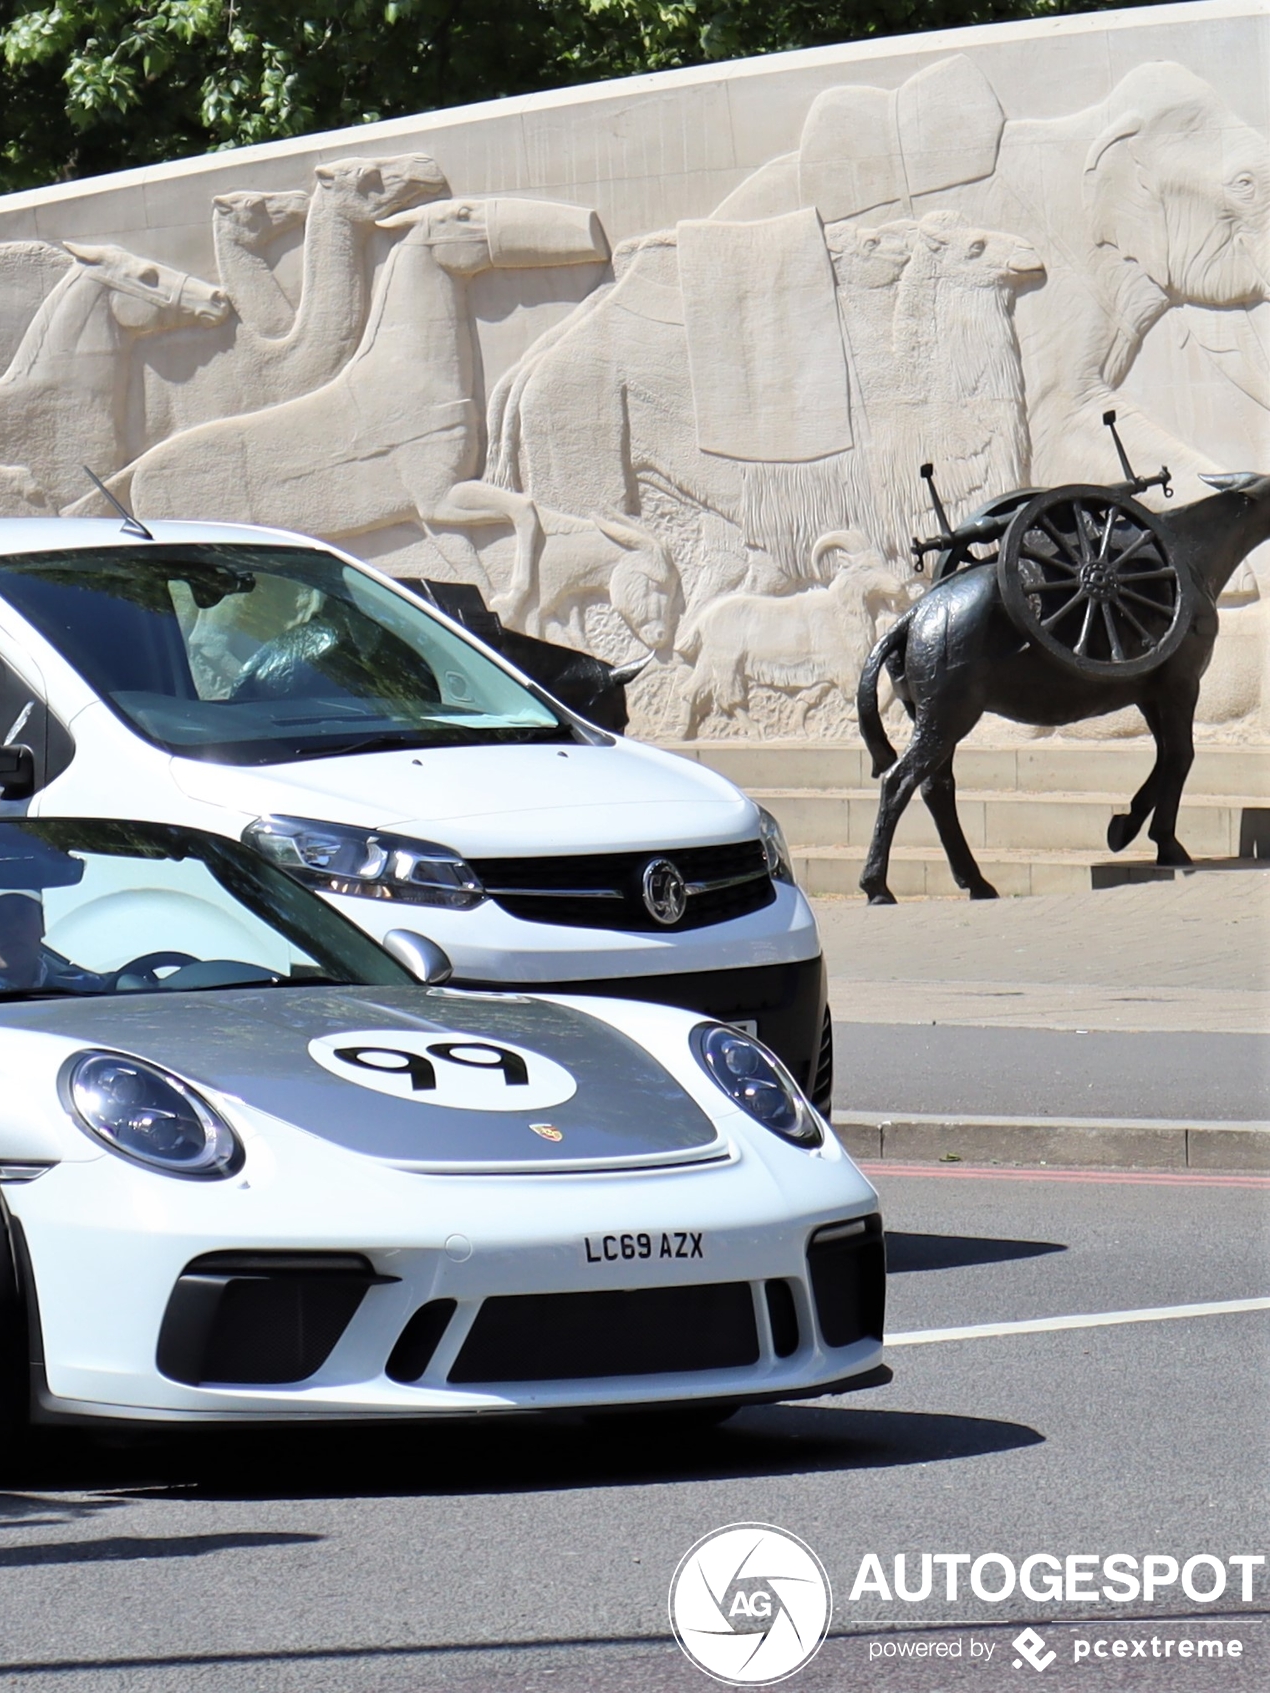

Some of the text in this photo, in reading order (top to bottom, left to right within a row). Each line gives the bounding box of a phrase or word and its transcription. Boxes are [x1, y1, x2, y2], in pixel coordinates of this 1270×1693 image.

[333, 1042, 530, 1092] 99
[584, 1232, 704, 1264] LC69 AZX
